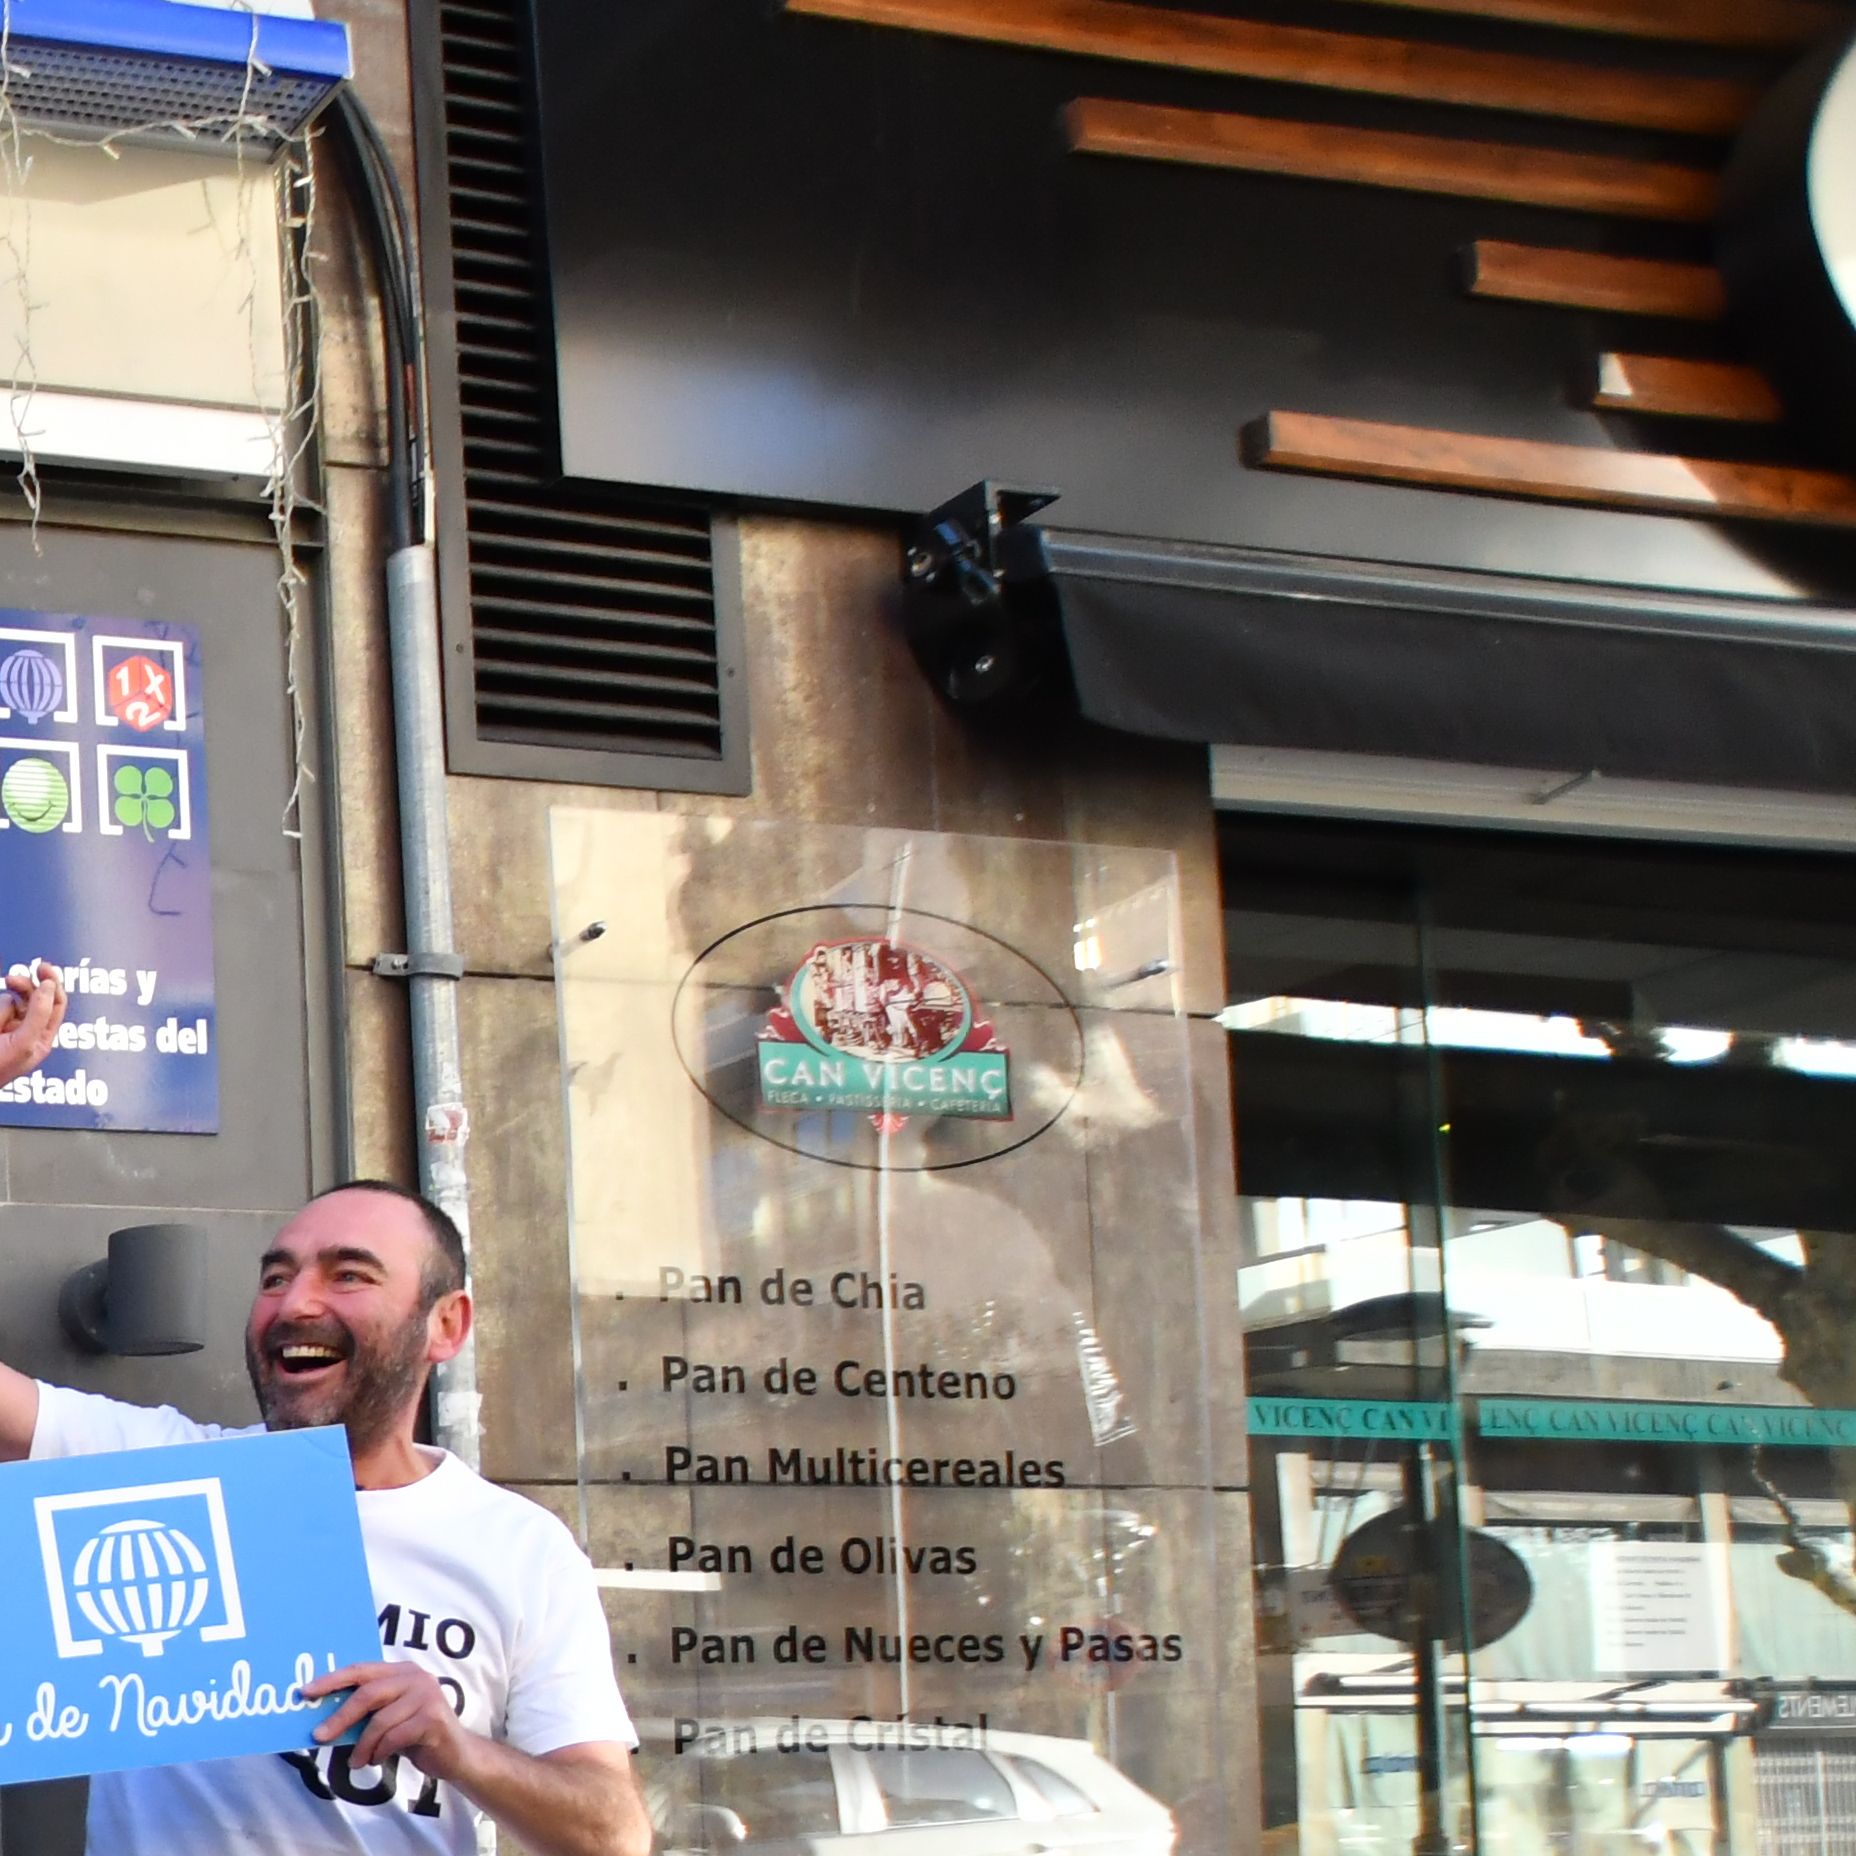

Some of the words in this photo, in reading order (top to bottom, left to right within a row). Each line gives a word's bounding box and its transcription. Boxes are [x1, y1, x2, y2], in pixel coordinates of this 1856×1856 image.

[136, 970, 157, 1006] y
[156, 1017, 208, 1055] del
[763, 1059, 846, 1087] CAN
[862, 1062, 1004, 1100] VICENÇ
[767, 1089, 809, 1105] FLECA
[659, 1266, 742, 1304] Pan
[760, 1267, 813, 1307] de
[830, 1271, 926, 1310] Chia
[662, 1355, 744, 1393] Pan
[764, 1357, 816, 1395] de
[834, 1360, 1017, 1400] Centeno
[1255, 1404, 1352, 1433] VICENÇ
[1362, 1407, 1415, 1431] CAN
[665, 1446, 749, 1483] Pan
[768, 1448, 1065, 1488] Multicereales
[668, 1537, 751, 1573] Pan
[770, 1536, 823, 1574] de
[840, 1536, 976, 1575] Olivas
[671, 1626, 755, 1663] Pan
[774, 1625, 826, 1663] de
[845, 1626, 1004, 1663] Nueces
[1020, 1634, 1044, 1670] y
[1060, 1626, 1182, 1662] Pasas
[26, 1682, 89, 1742] de
[674, 1716, 758, 1755] Pan
[776, 1715, 829, 1754] de
[847, 1713, 988, 1752] Cristal
